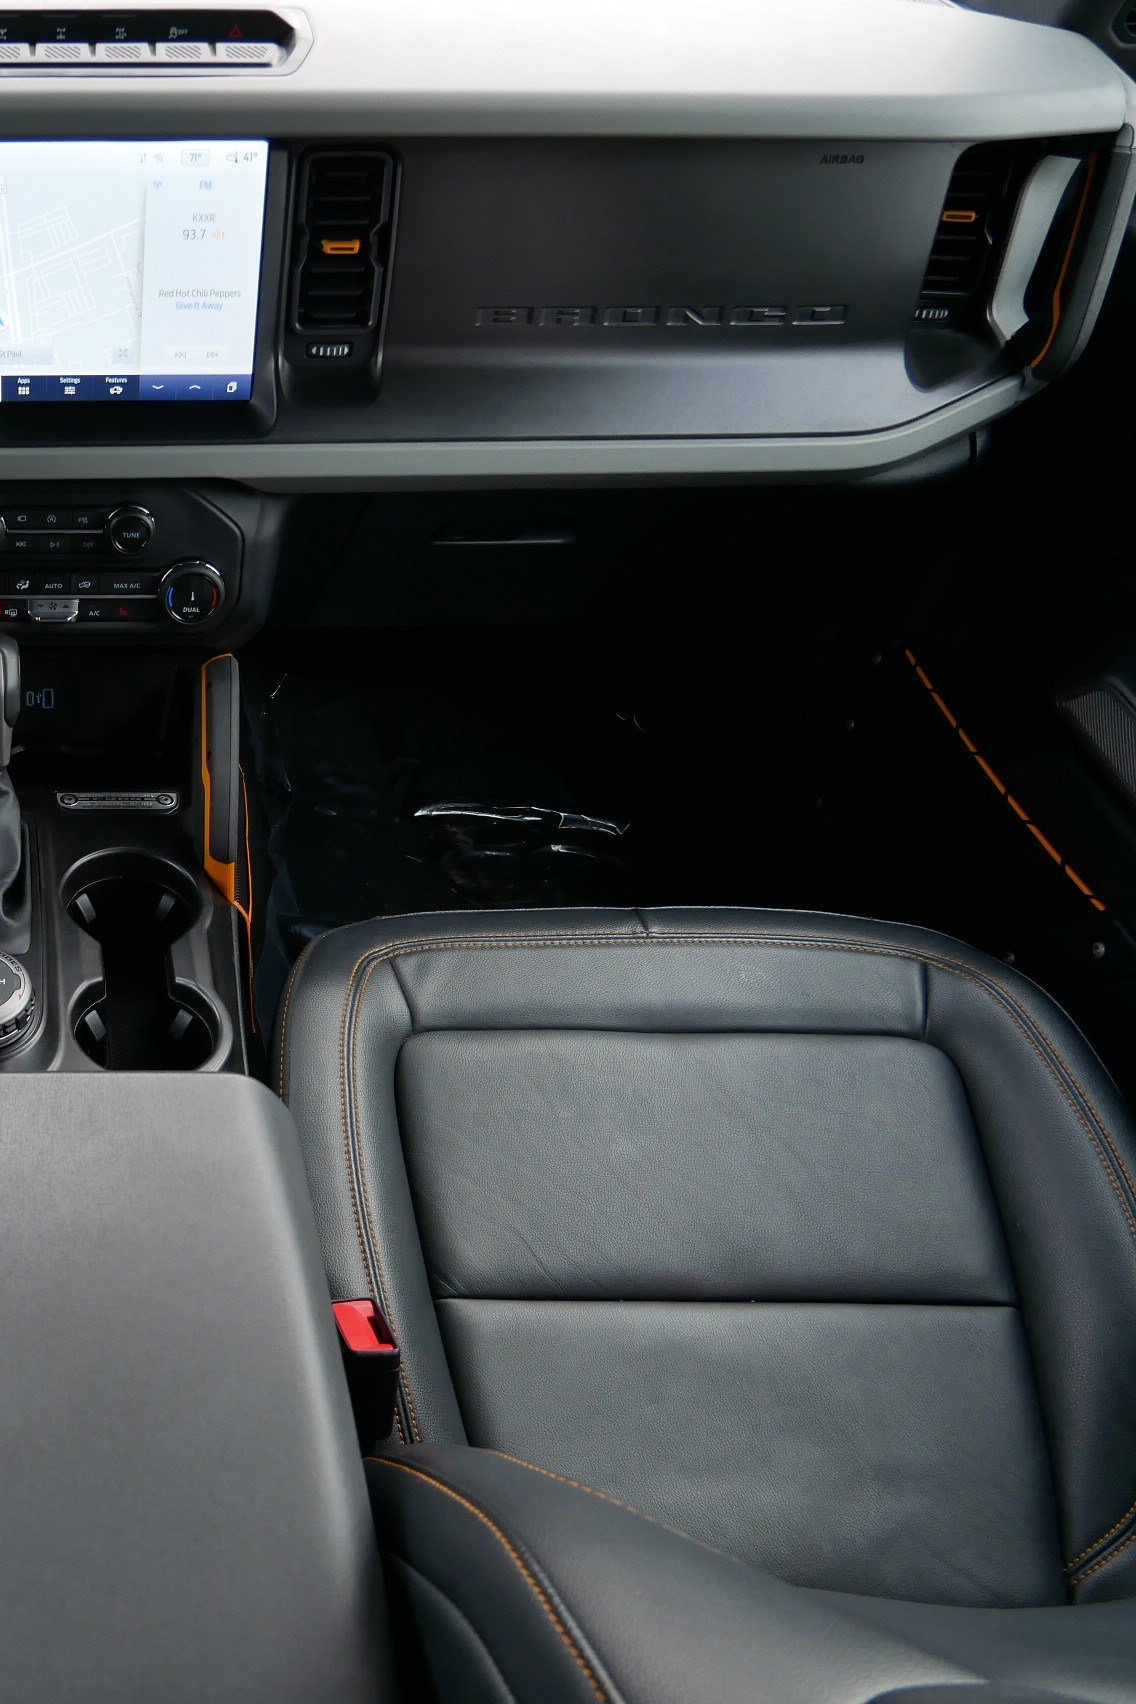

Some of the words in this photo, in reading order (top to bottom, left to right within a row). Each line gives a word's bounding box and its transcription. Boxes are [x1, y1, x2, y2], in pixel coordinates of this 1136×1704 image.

[190, 154, 202, 162] 71°
[243, 152, 258, 162] 41°
[820, 154, 864, 164] AIRBAG
[199, 180, 212, 190] FM
[192, 214, 216, 223] KXXR
[182, 229, 206, 240] 93.7
[158, 290, 174, 298] Red
[176, 290, 190, 298] Hot
[192, 289, 208, 298] Chili
[210, 289, 241, 299] Peppers
[175, 302, 192, 310] Give
[194, 302, 200, 310] It
[202, 302, 223, 312] Away
[475, 305, 850, 327] BRONCO
